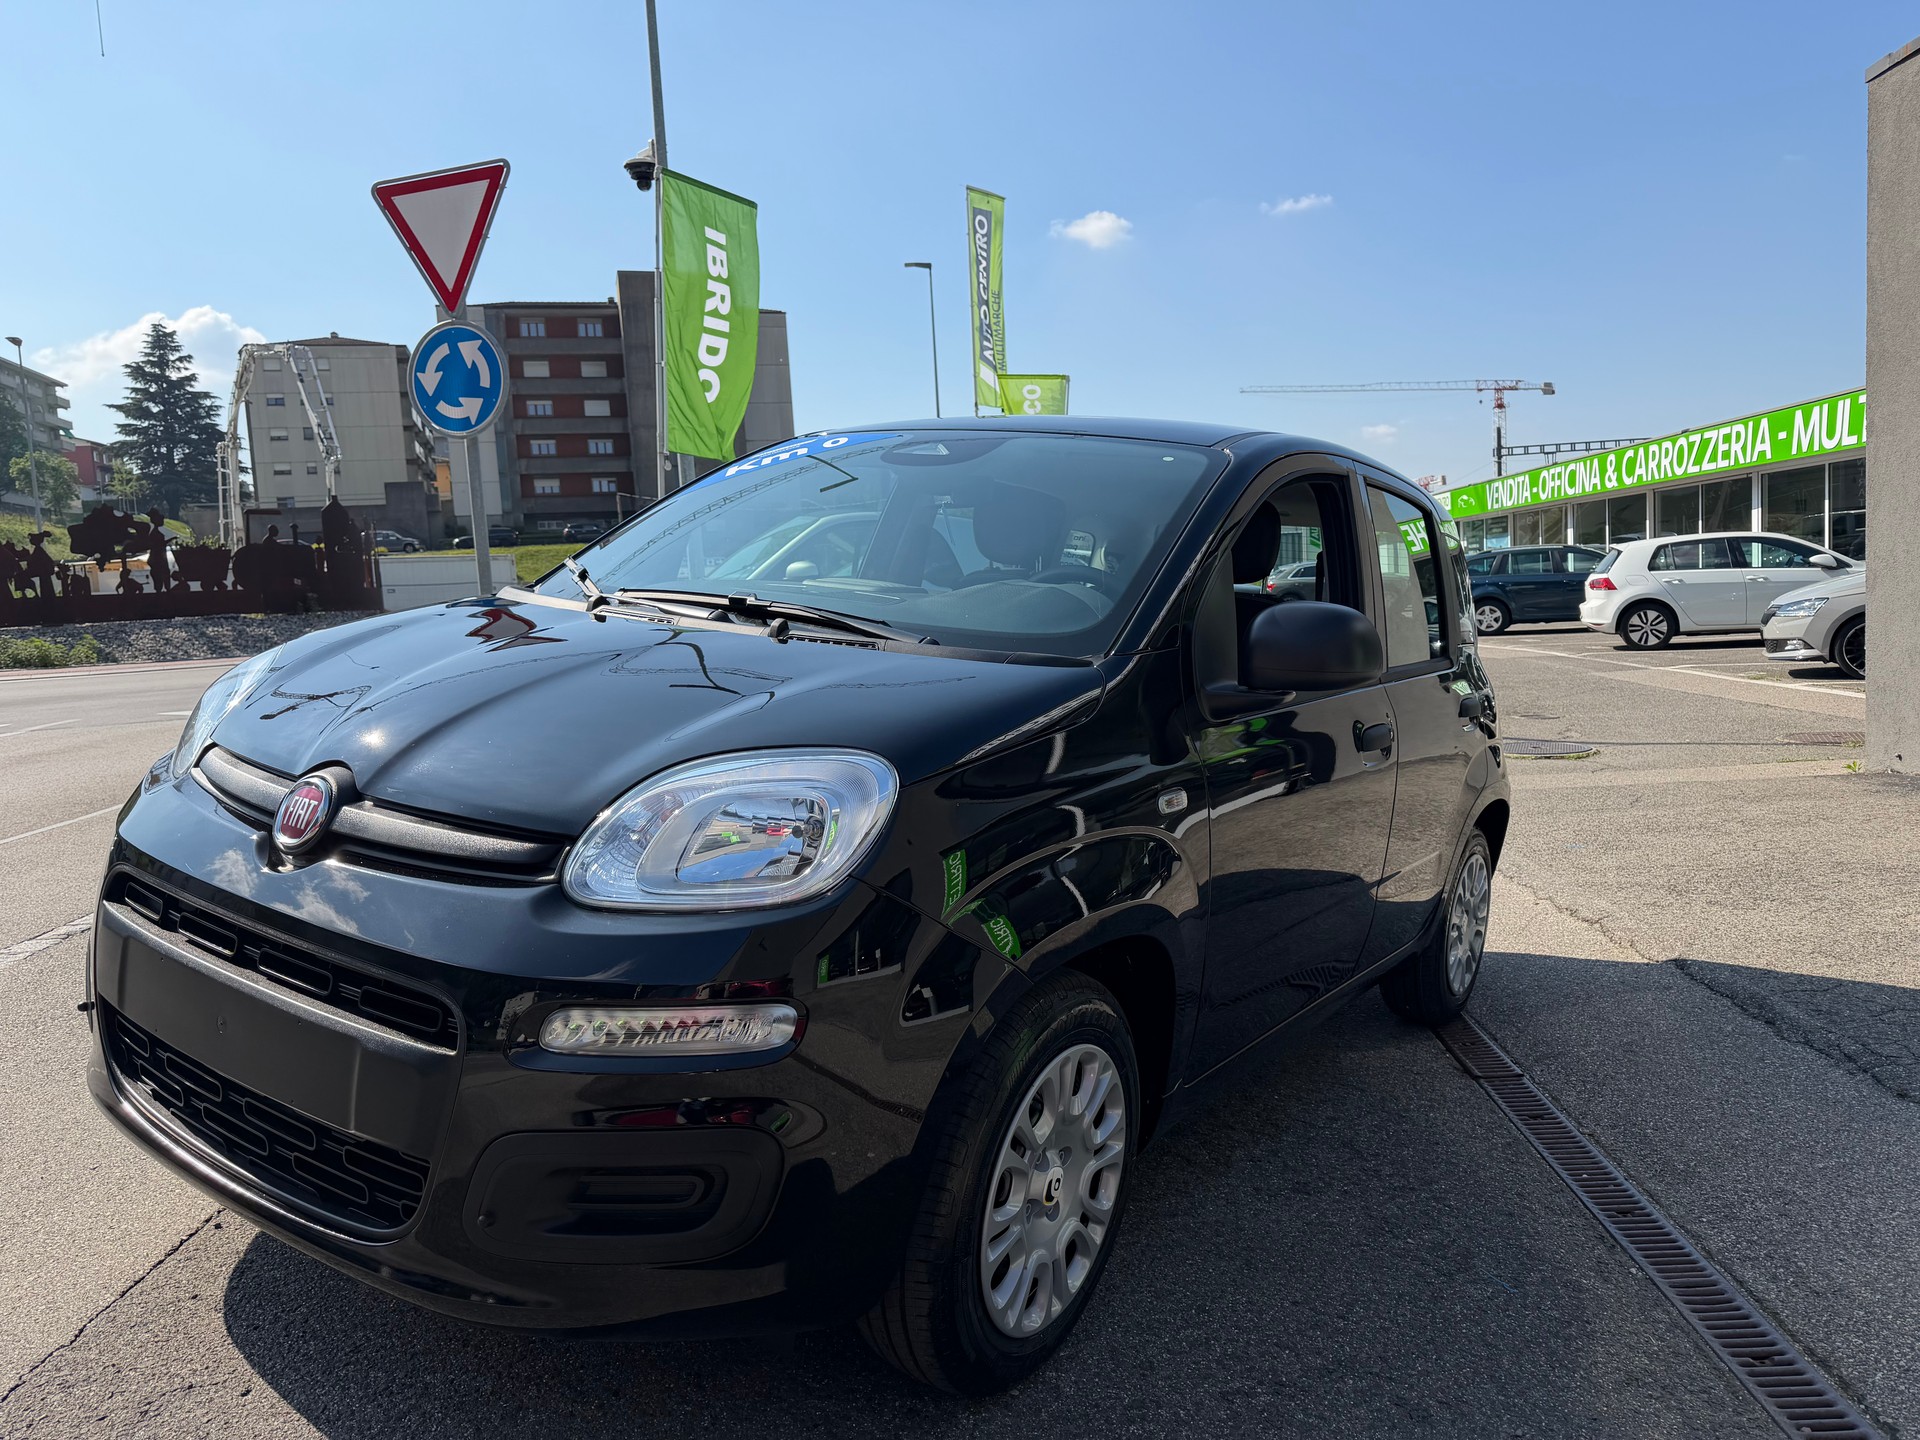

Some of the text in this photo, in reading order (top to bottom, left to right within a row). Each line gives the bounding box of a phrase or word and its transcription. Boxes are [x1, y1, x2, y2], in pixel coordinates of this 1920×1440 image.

[974, 214, 996, 366] AUTO CENTRO
[991, 290, 1006, 371] MULTIMARCHE
[1486, 474, 1532, 510] VENDITA
[1538, 458, 1602, 501] OFFICINA
[1605, 453, 1618, 488] &
[1621, 417, 1773, 485] CARROZZERIA
[283, 796, 319, 830] FIAT
